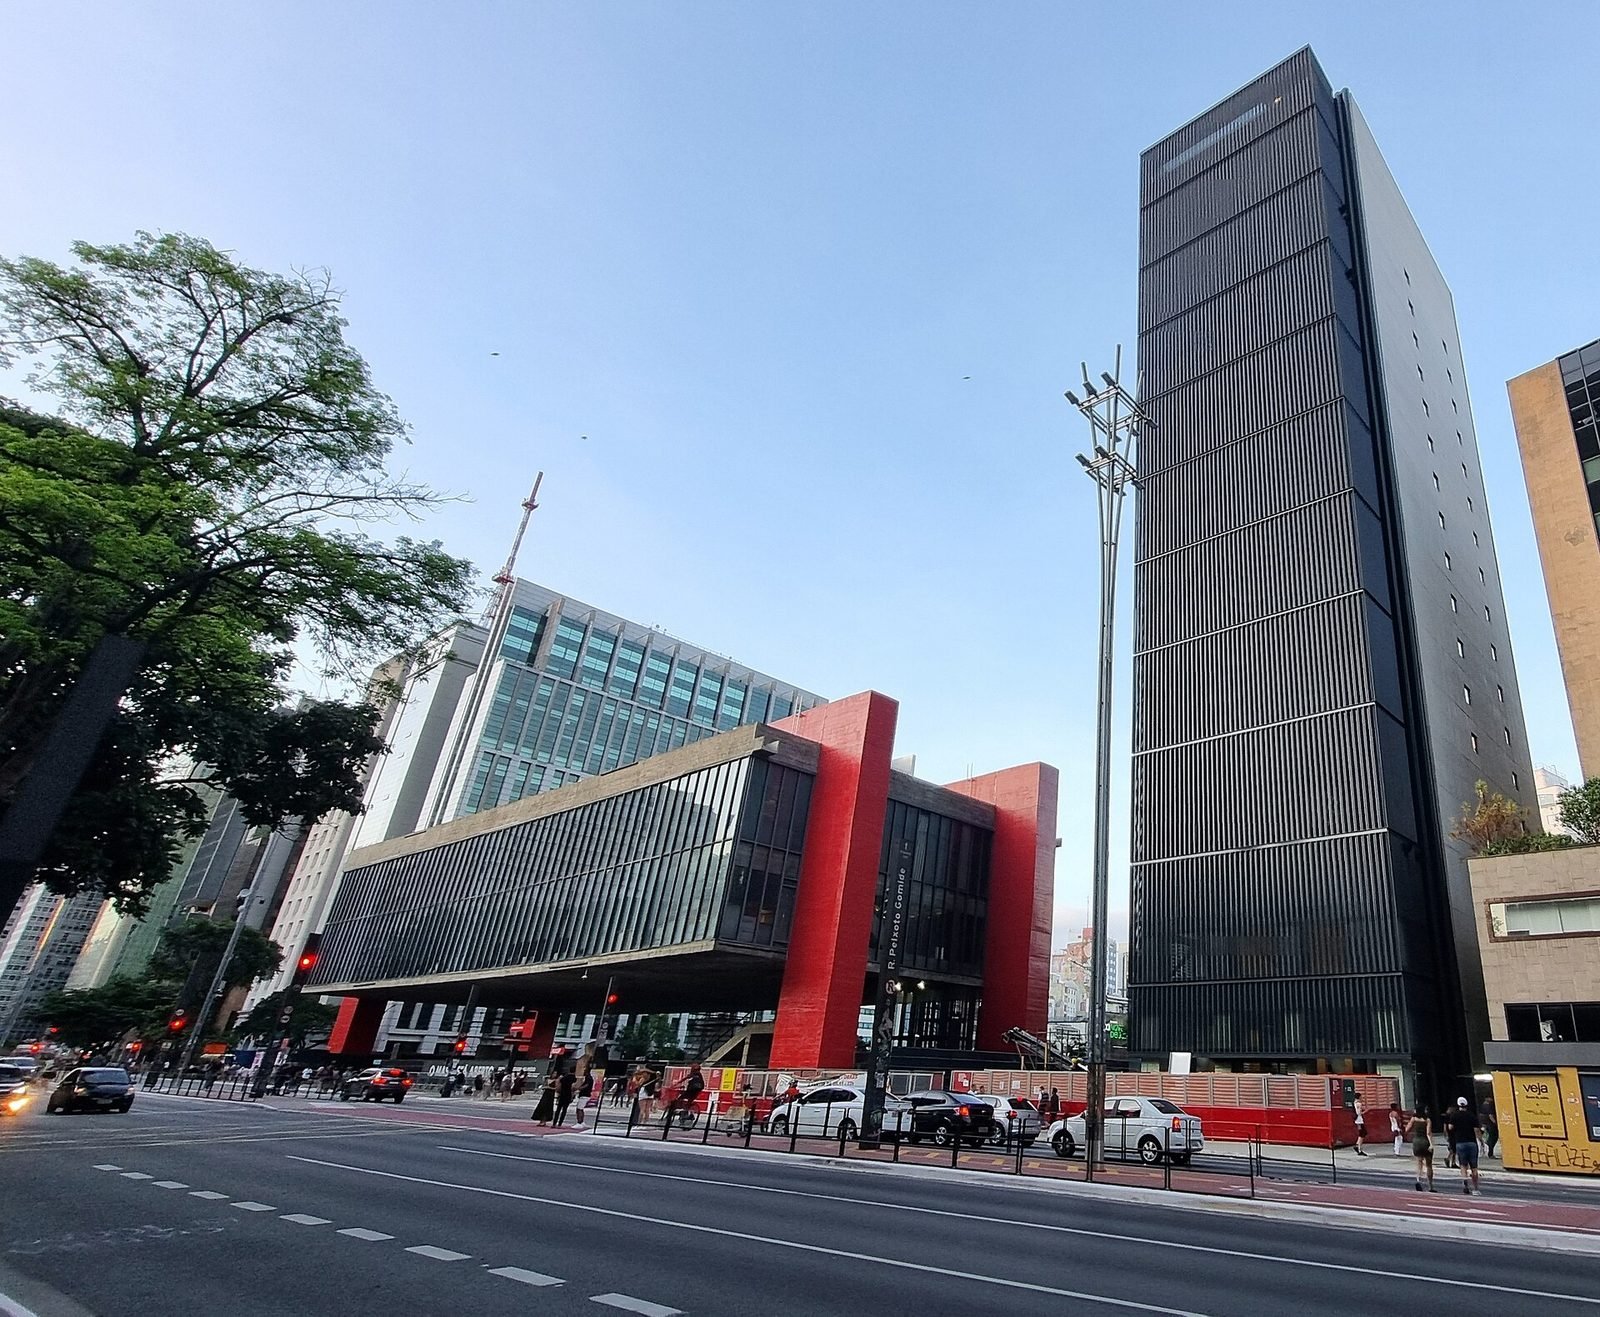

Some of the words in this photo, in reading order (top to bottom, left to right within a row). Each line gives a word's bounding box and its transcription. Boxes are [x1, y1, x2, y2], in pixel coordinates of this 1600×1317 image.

[895, 868, 906, 909] Gomide
[889, 913, 901, 956] Peixoto
[888, 959, 896, 969] R.
[1523, 1083, 1548, 1095] veja
